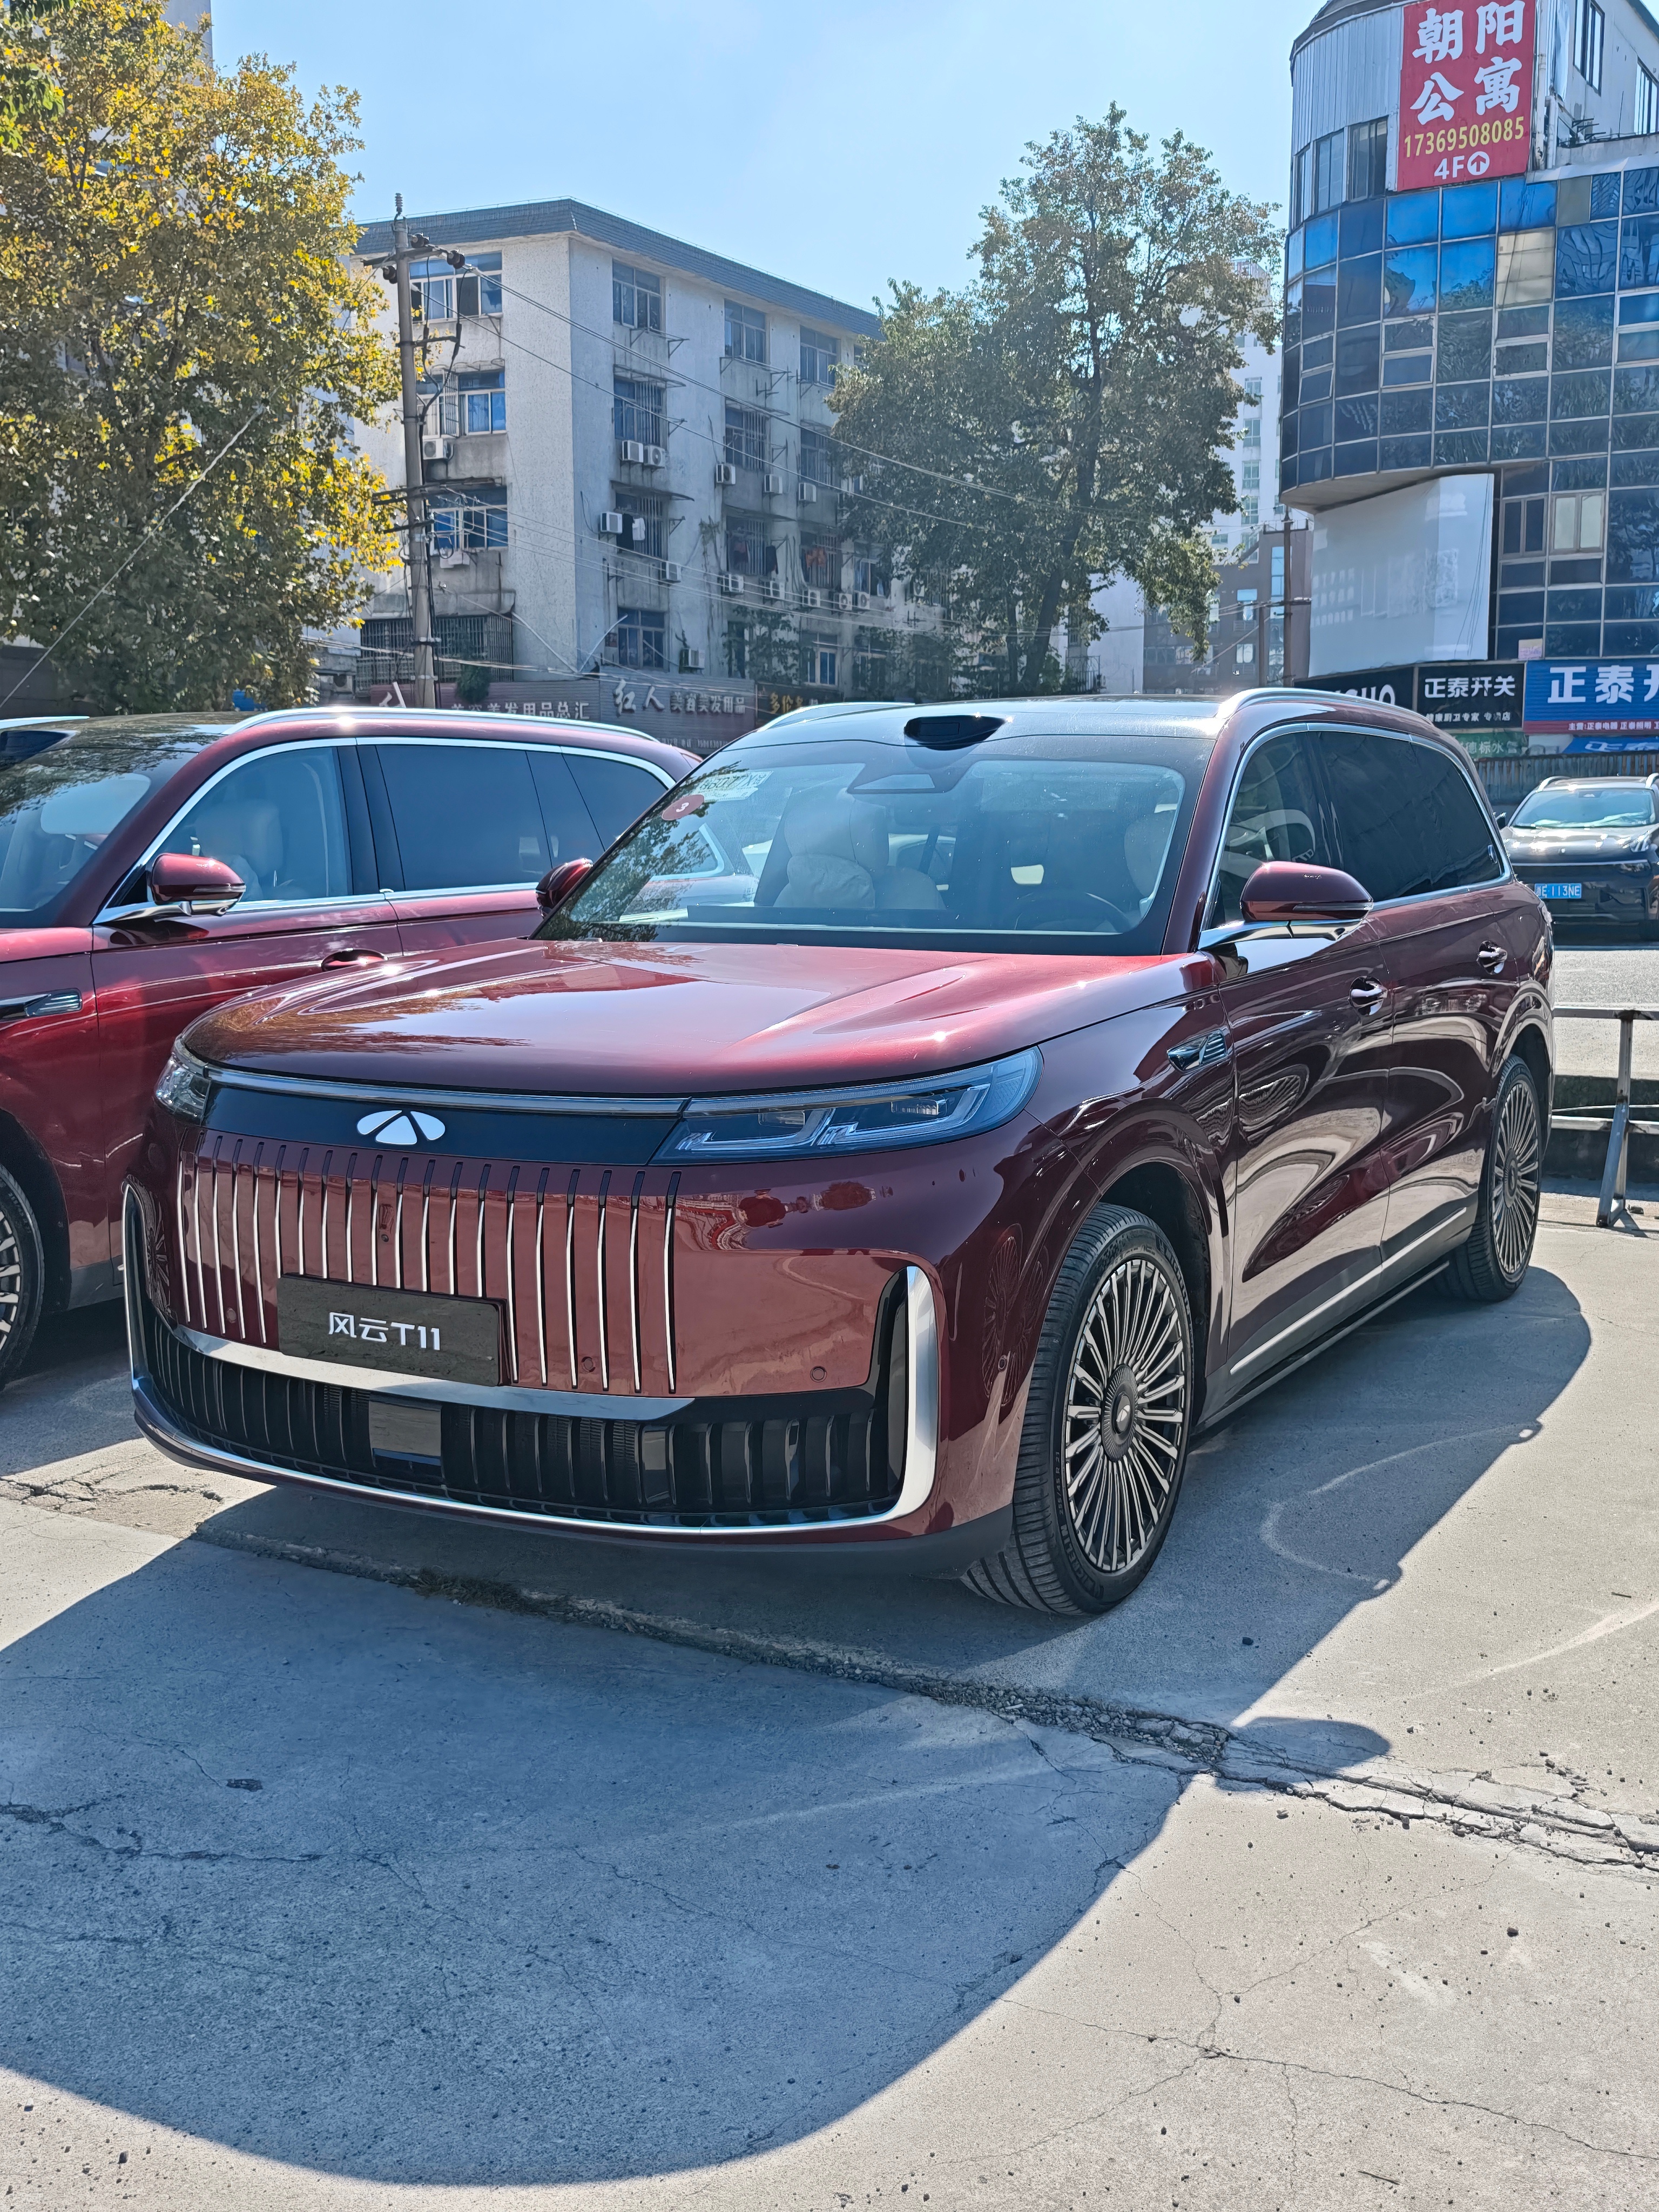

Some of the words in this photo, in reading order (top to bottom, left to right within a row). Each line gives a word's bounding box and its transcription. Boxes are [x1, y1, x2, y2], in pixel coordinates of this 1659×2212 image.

[1412, 0, 1526, 64] 朝阳
[1410, 56, 1522, 125] 公寓
[1404, 116, 1525, 158] 17369508085
[1434, 155, 1465, 180] 4F
[1425, 676, 1515, 698] 正泰开关
[328, 1312, 440, 1351] 风云T11
